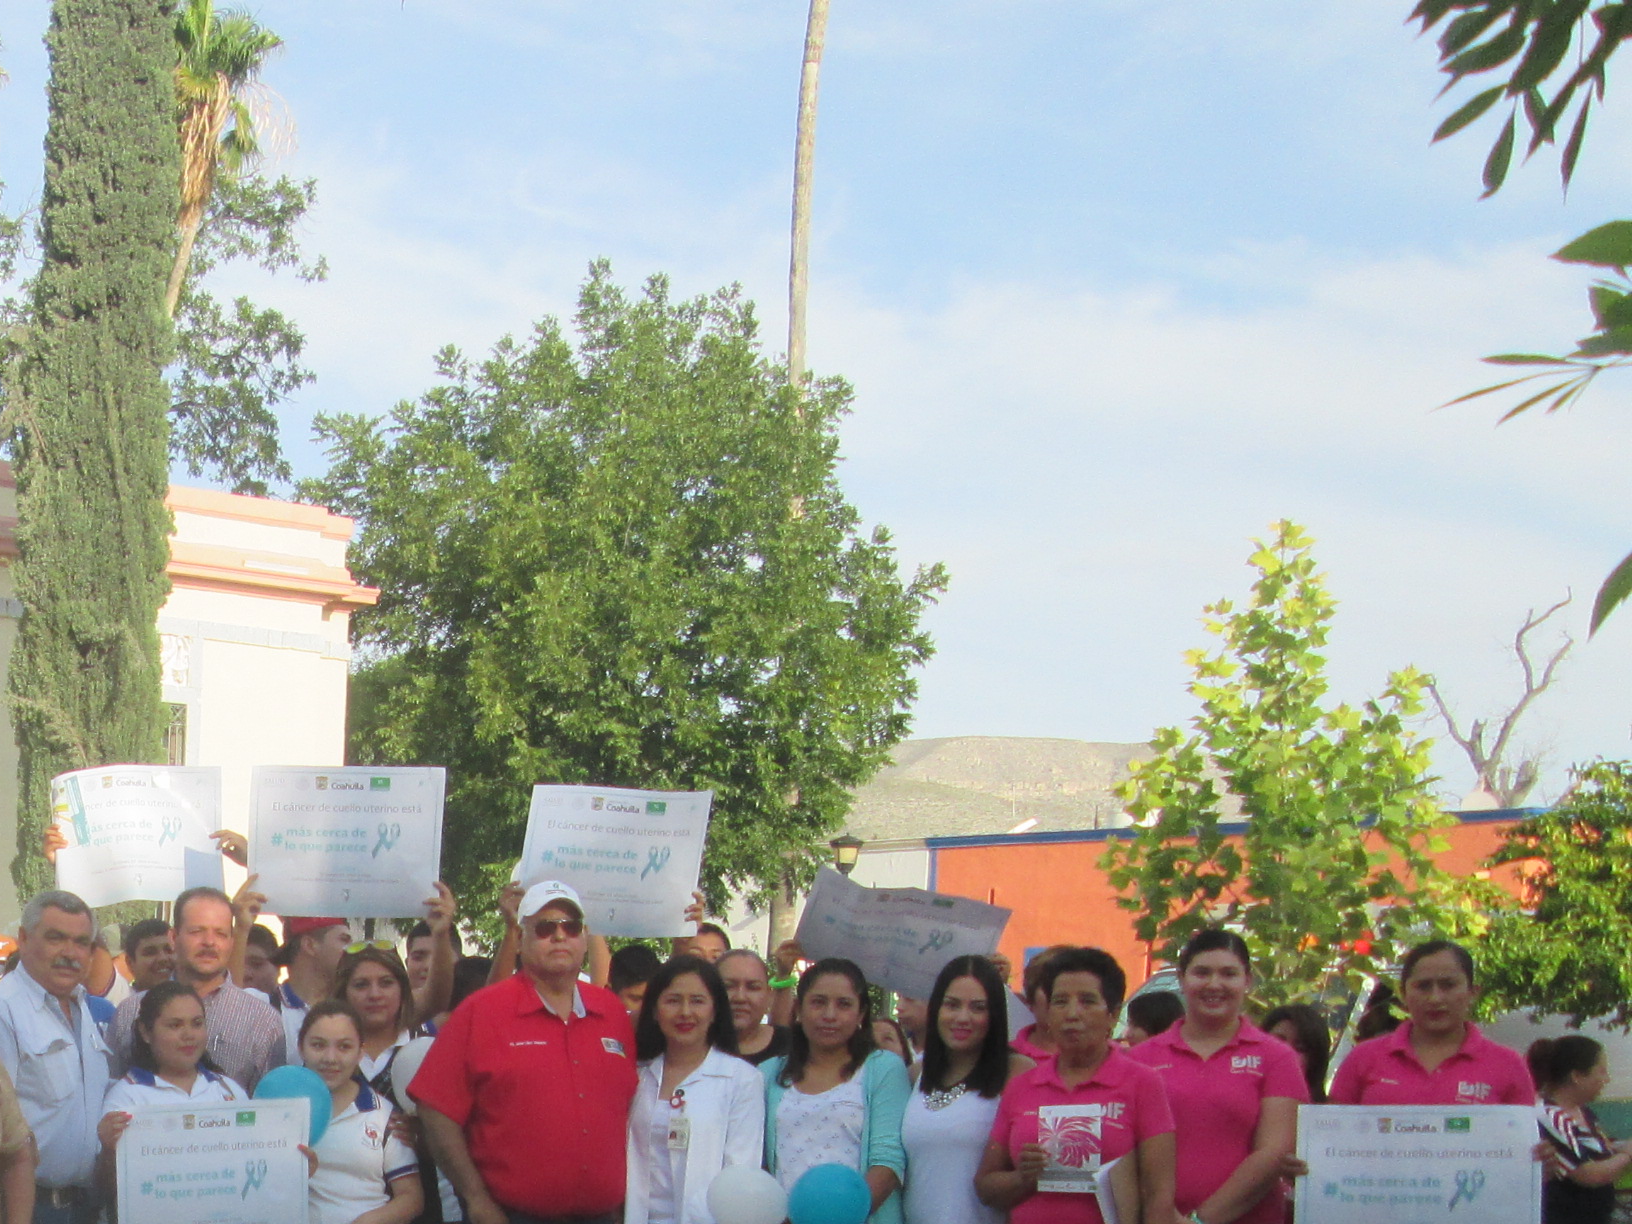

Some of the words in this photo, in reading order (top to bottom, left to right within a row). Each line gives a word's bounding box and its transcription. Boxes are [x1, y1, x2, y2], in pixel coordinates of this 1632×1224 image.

[116, 779, 146, 787] Coahuila
[331, 782, 364, 790] Coahuila
[85, 801, 103, 810] ncer
[273, 802, 281, 811] El
[283, 802, 316, 811] cáncer
[318, 802, 330, 812] de
[333, 802, 361, 812] cuello
[363, 803, 399, 813] uterino
[401, 803, 422, 813] está
[286, 826, 312, 837] más
[316, 828, 348, 838] cerca
[351, 827, 366, 838] de
[285, 842, 295, 850] lo
[299, 843, 323, 853] que
[325, 843, 367, 853] parece
[198, 1119, 231, 1128] Coahuila
[141, 1146, 150, 1156] El
[152, 1144, 184, 1155] cáncer
[186, 1144, 198, 1154] de
[202, 1142, 230, 1153] cuello
[231, 1140, 265, 1151] uterino
[267, 1139, 287, 1149] está
[156, 1170, 182, 1183] más
[186, 1170, 217, 1181] cerca
[221, 1168, 235, 1179] de
[155, 1188, 166, 1198] lo
[170, 1186, 193, 1201] que
[197, 1185, 236, 1198] parece
